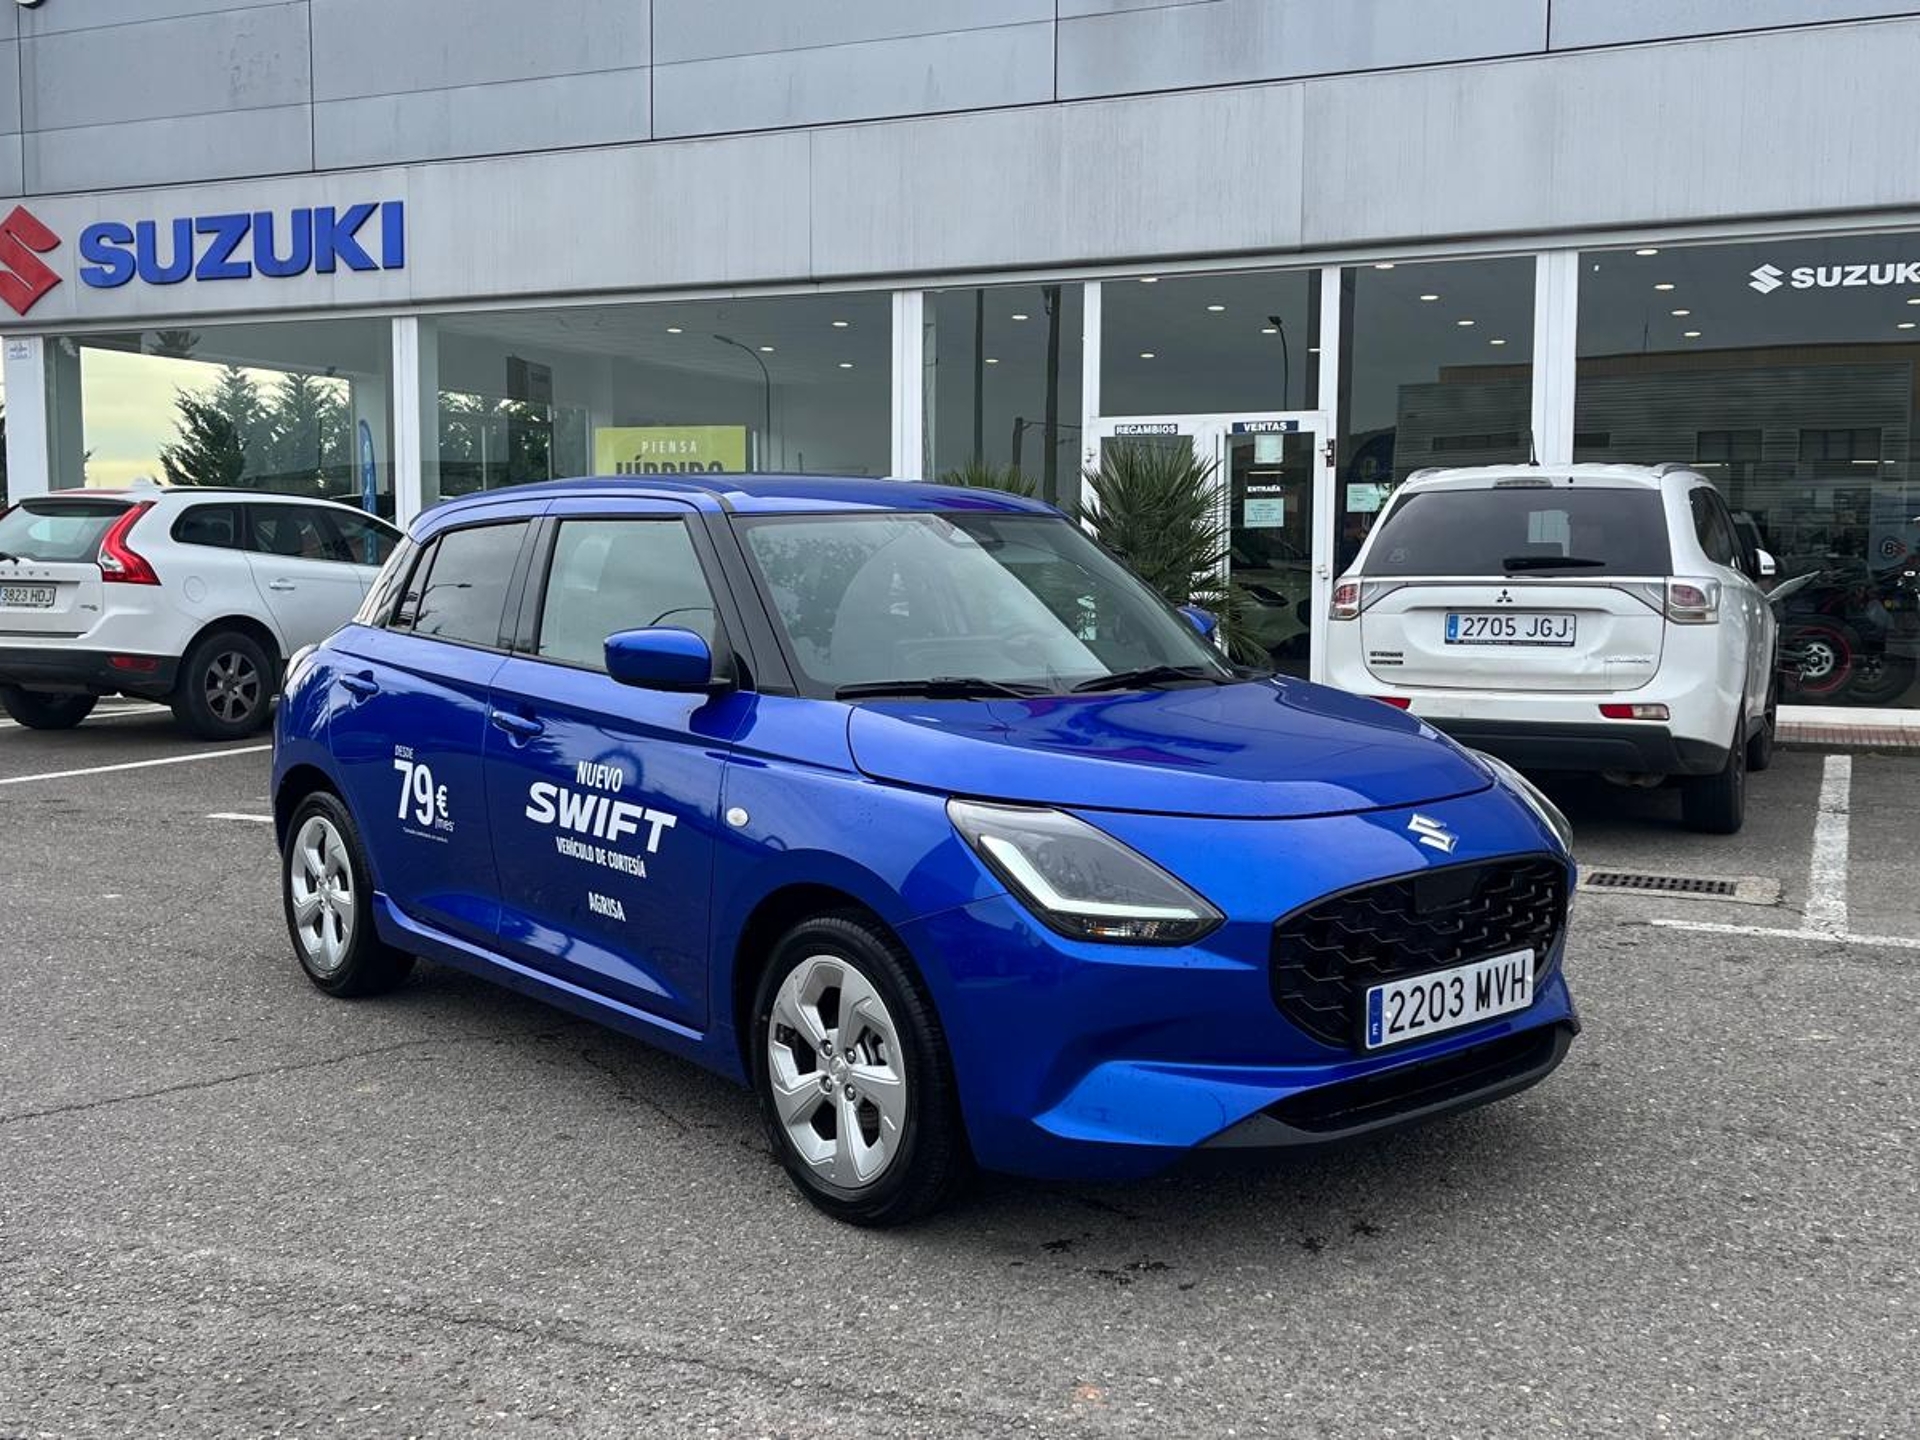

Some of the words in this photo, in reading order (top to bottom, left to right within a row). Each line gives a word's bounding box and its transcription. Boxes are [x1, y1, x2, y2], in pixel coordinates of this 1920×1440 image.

[79, 200, 404, 288] SUZUKI
[1116, 425, 1177, 435] RECAMBIOS
[1243, 421, 1288, 432] VENTAS
[641, 440, 697, 454] PIENSA
[1462, 617, 1516, 636] 2705
[1526, 617, 1567, 637] JGJ
[395, 744, 414, 759] DESDE
[576, 761, 623, 793] NUEVO
[525, 781, 678, 853] SWIFT
[555, 836, 595, 863] VEHÍCULO
[595, 847, 608, 867] DE
[608, 855, 647, 879] CORTESÍA
[588, 891, 627, 922] AGRISA
[1388, 976, 1464, 1035] 2203
[1476, 959, 1526, 1012] MVH
